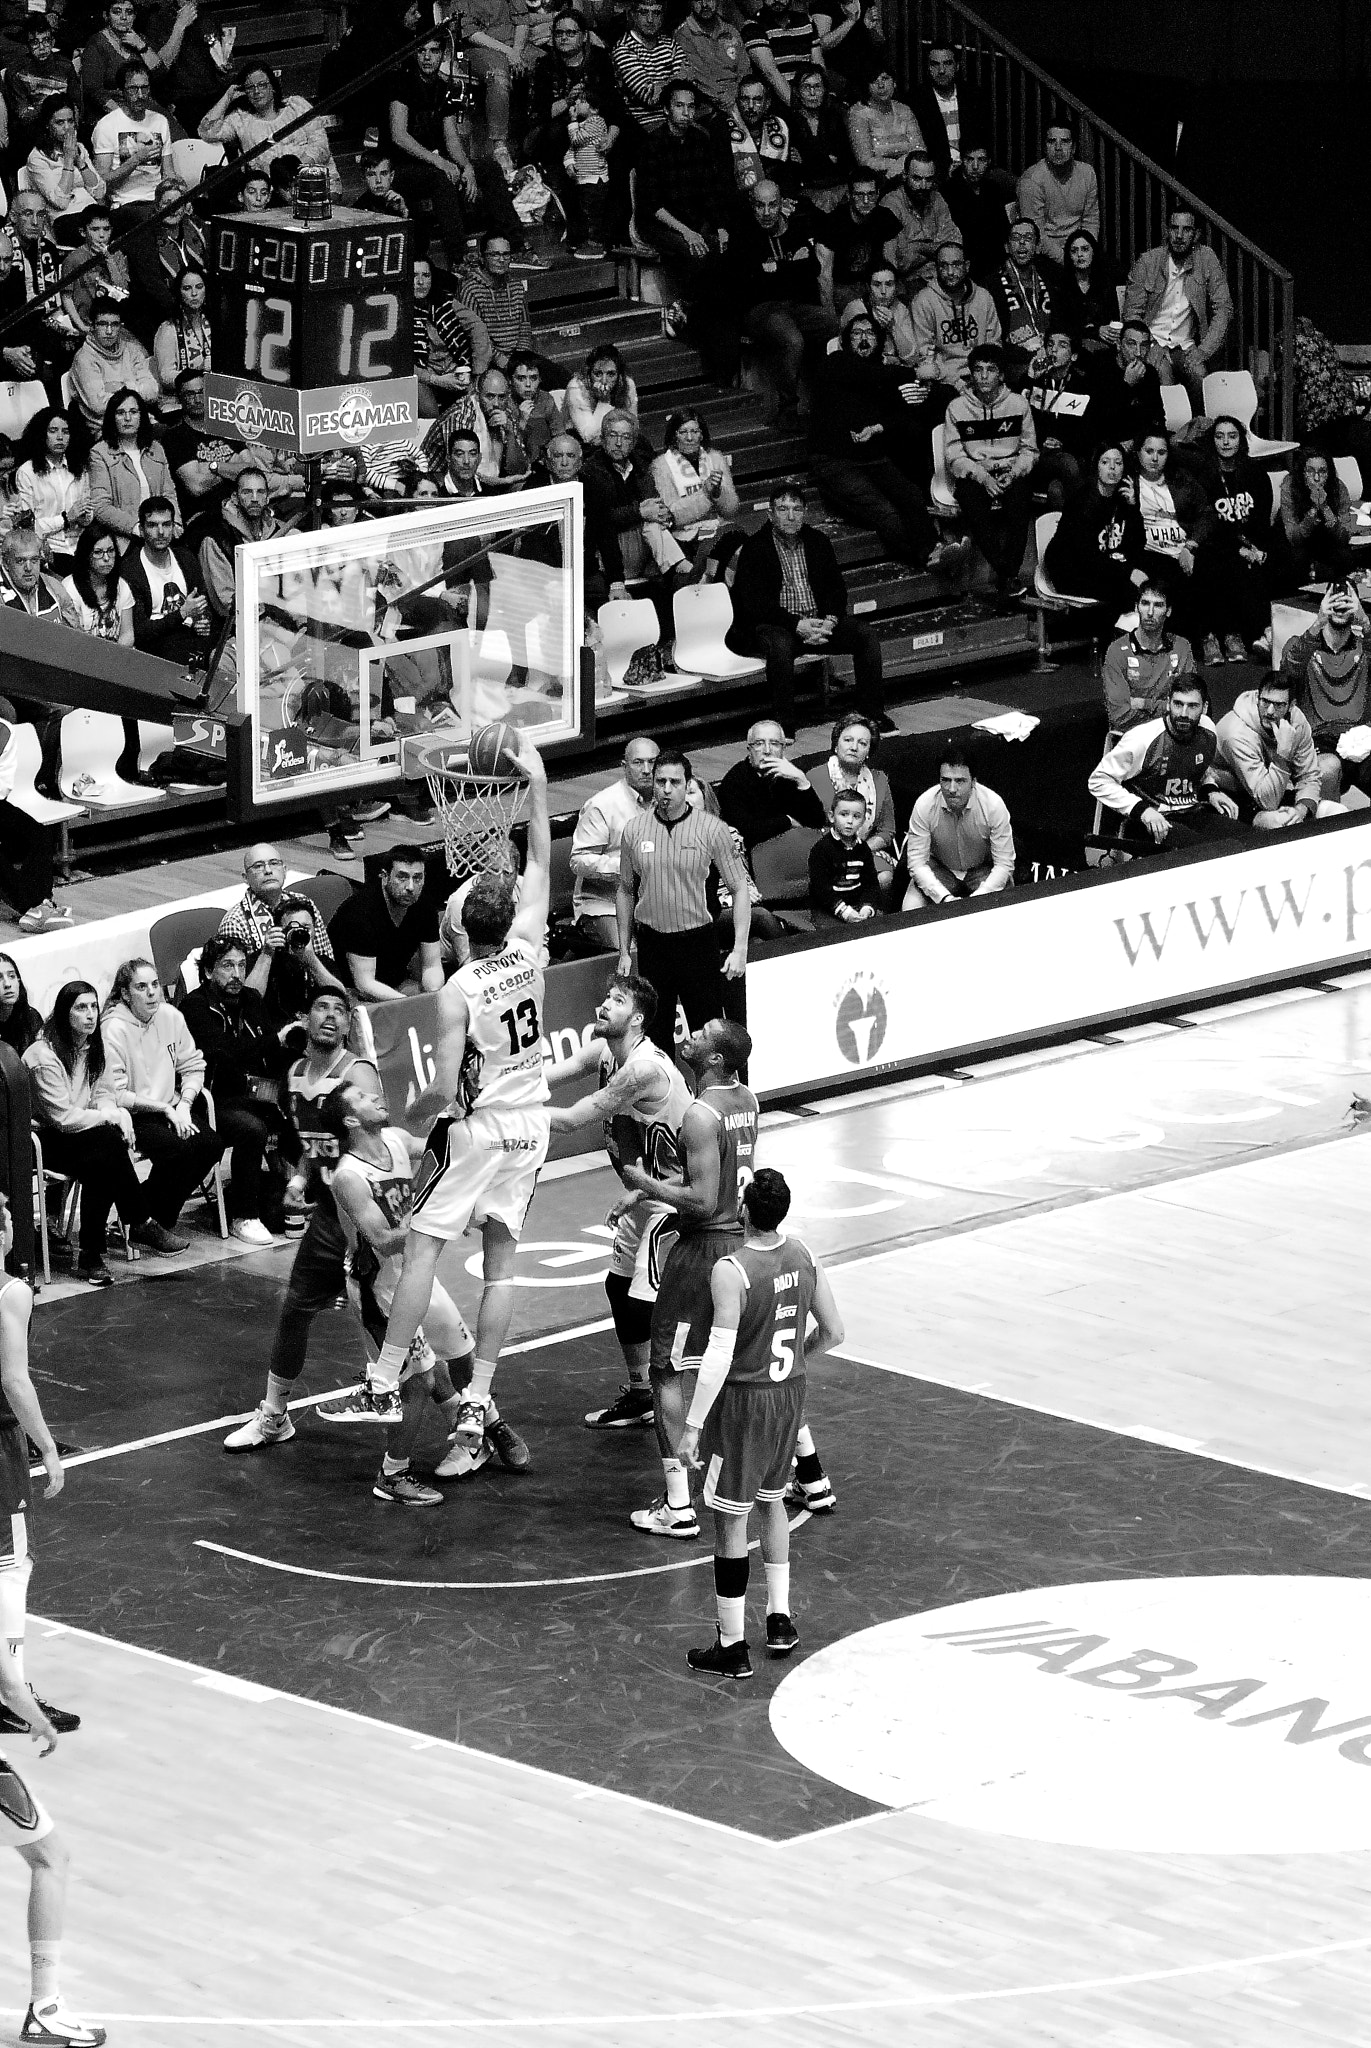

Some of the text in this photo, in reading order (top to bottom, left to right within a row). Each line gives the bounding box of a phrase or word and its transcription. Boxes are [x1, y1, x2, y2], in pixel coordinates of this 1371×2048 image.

[245, 299, 291, 381] 12
[339, 294, 398, 378] 12
[208, 397, 295, 435] PESCAMAR
[306, 402, 412, 436] PESCAMAR
[281, 756, 305, 769] endesa
[499, 968, 535, 992] cenor
[500, 998, 540, 1056] 13
[768, 1328, 797, 1383] 5
